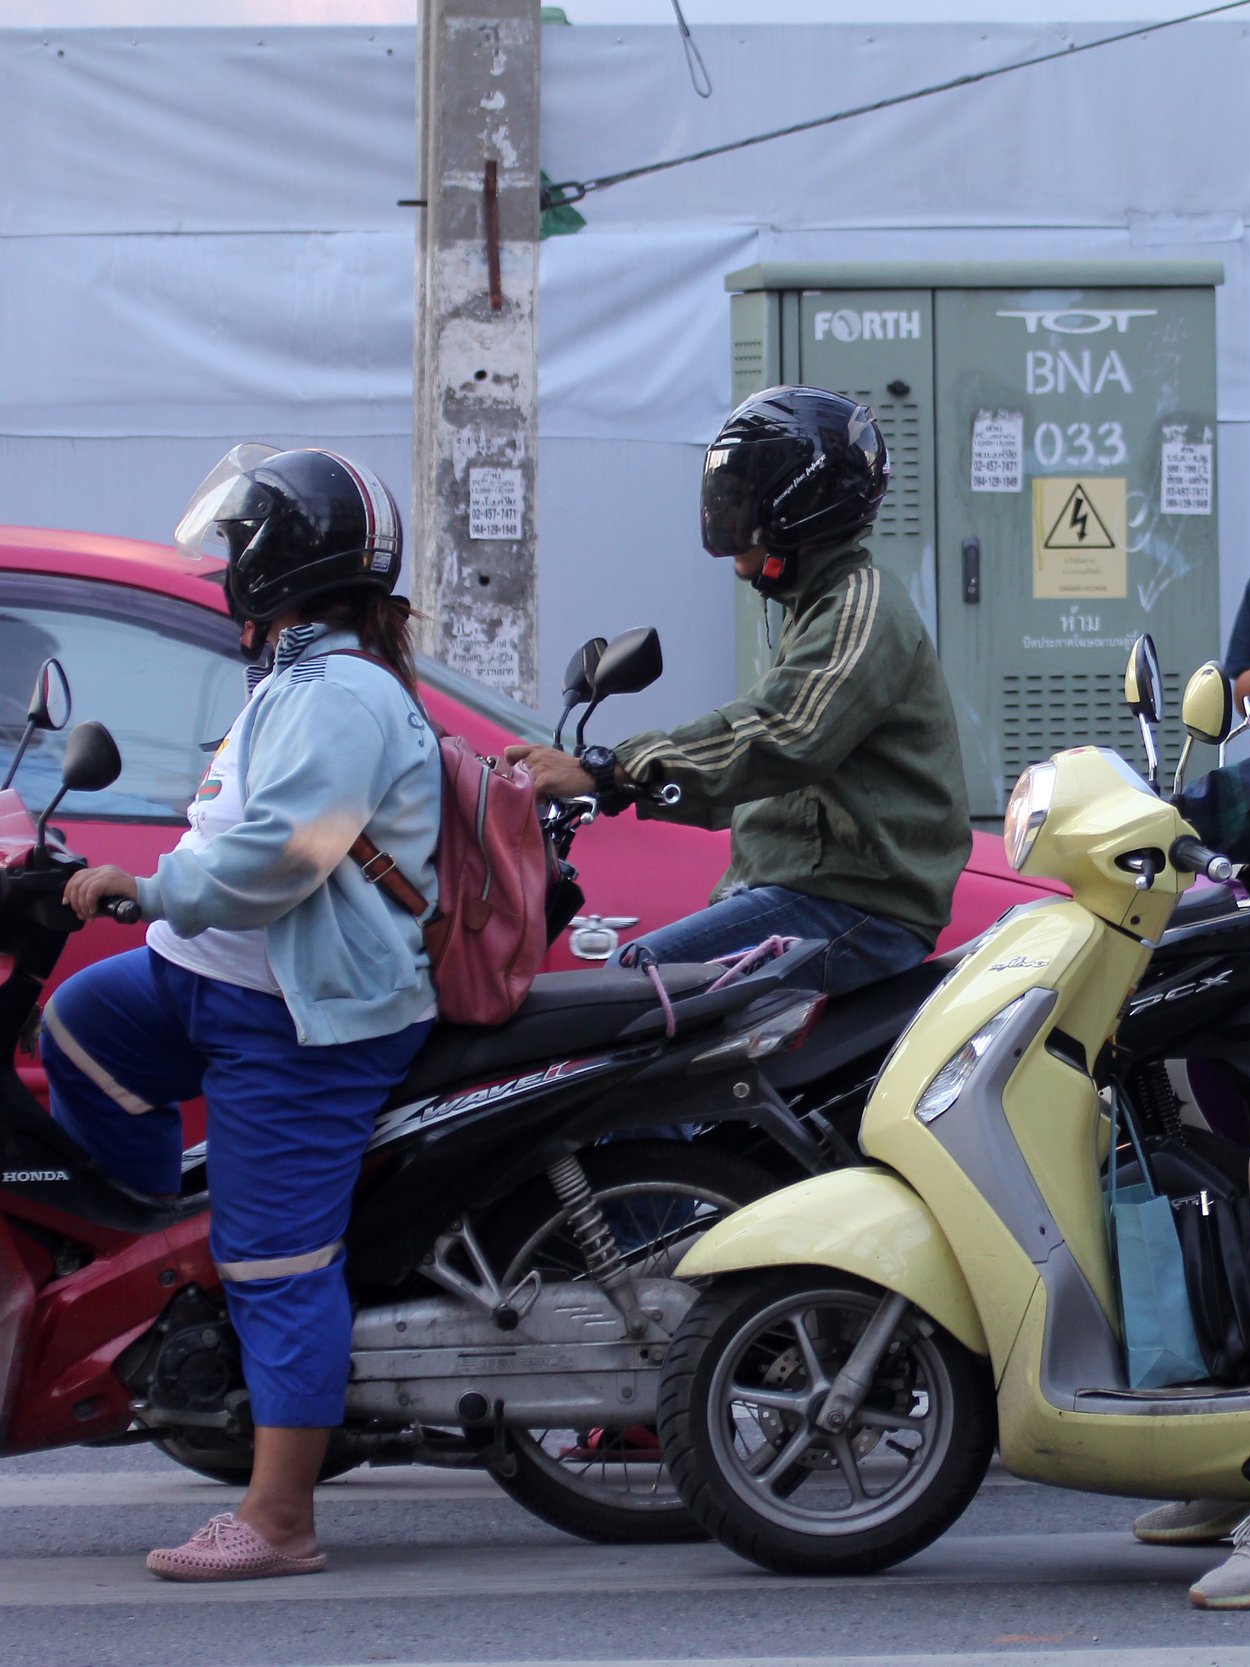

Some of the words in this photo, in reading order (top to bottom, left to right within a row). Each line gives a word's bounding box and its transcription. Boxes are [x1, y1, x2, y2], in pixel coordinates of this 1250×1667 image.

[814, 309, 920, 342] FORTH
[996, 310, 1157, 334] TOT
[1026, 350, 1132, 394] BNA
[1034, 422, 1127, 466] 033
[472, 508, 516, 520] 02-457-7471
[1060, 605, 1100, 632] ห้าม
[1130, 970, 1233, 1016] PCX
[2, 1170, 69, 1183] HONDA
